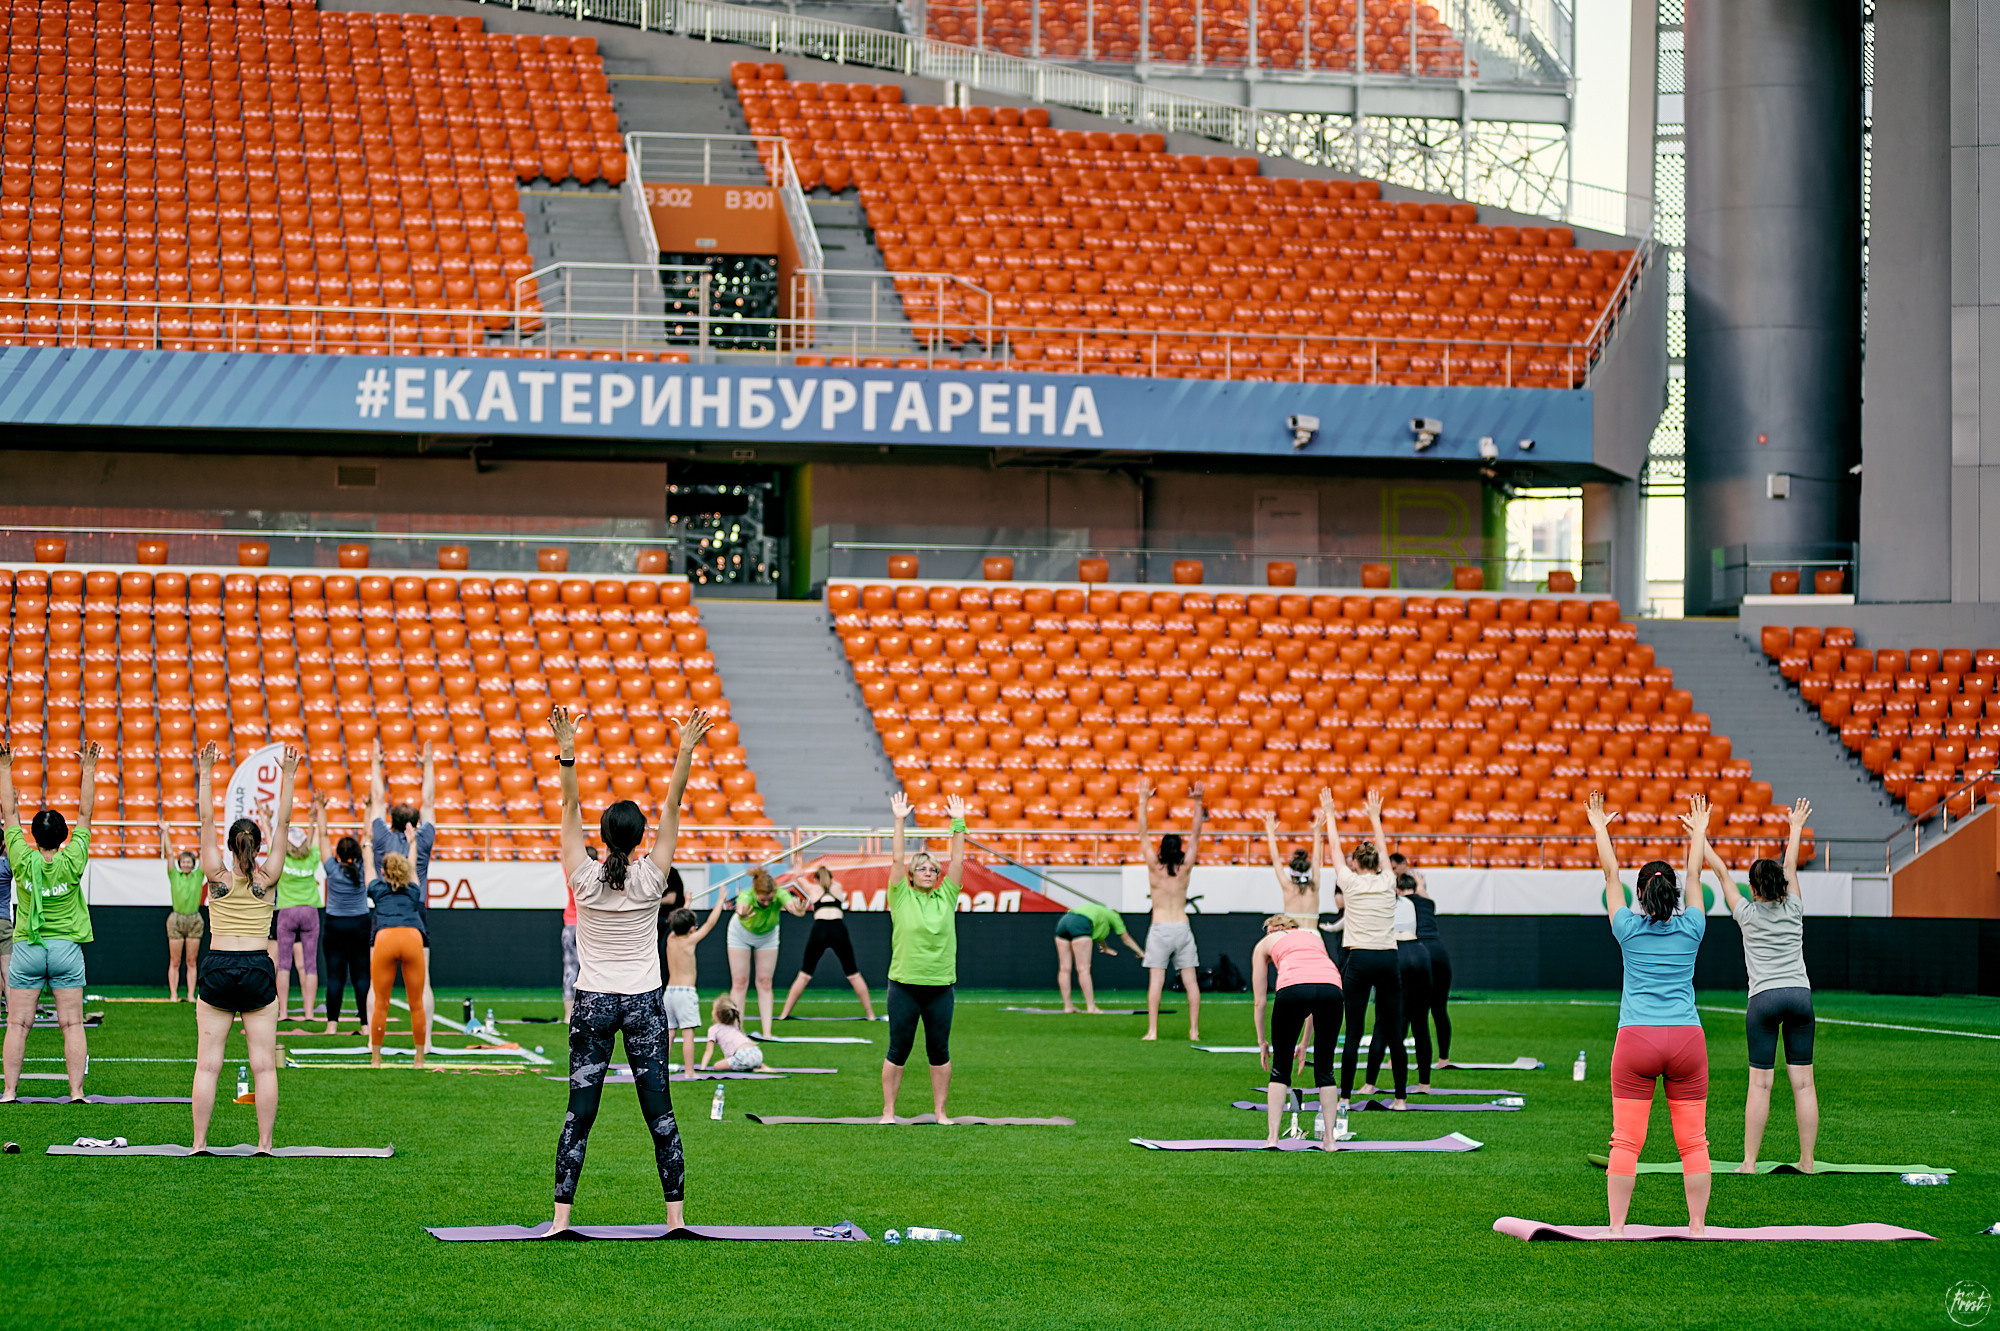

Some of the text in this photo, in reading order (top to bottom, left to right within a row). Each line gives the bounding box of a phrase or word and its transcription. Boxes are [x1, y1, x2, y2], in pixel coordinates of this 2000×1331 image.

[356, 367, 1103, 437] #ЕКАТЕРИНБУРГАРЕНА
[234, 786, 245, 821] GUAR
[52, 882, 68, 896] DAY
